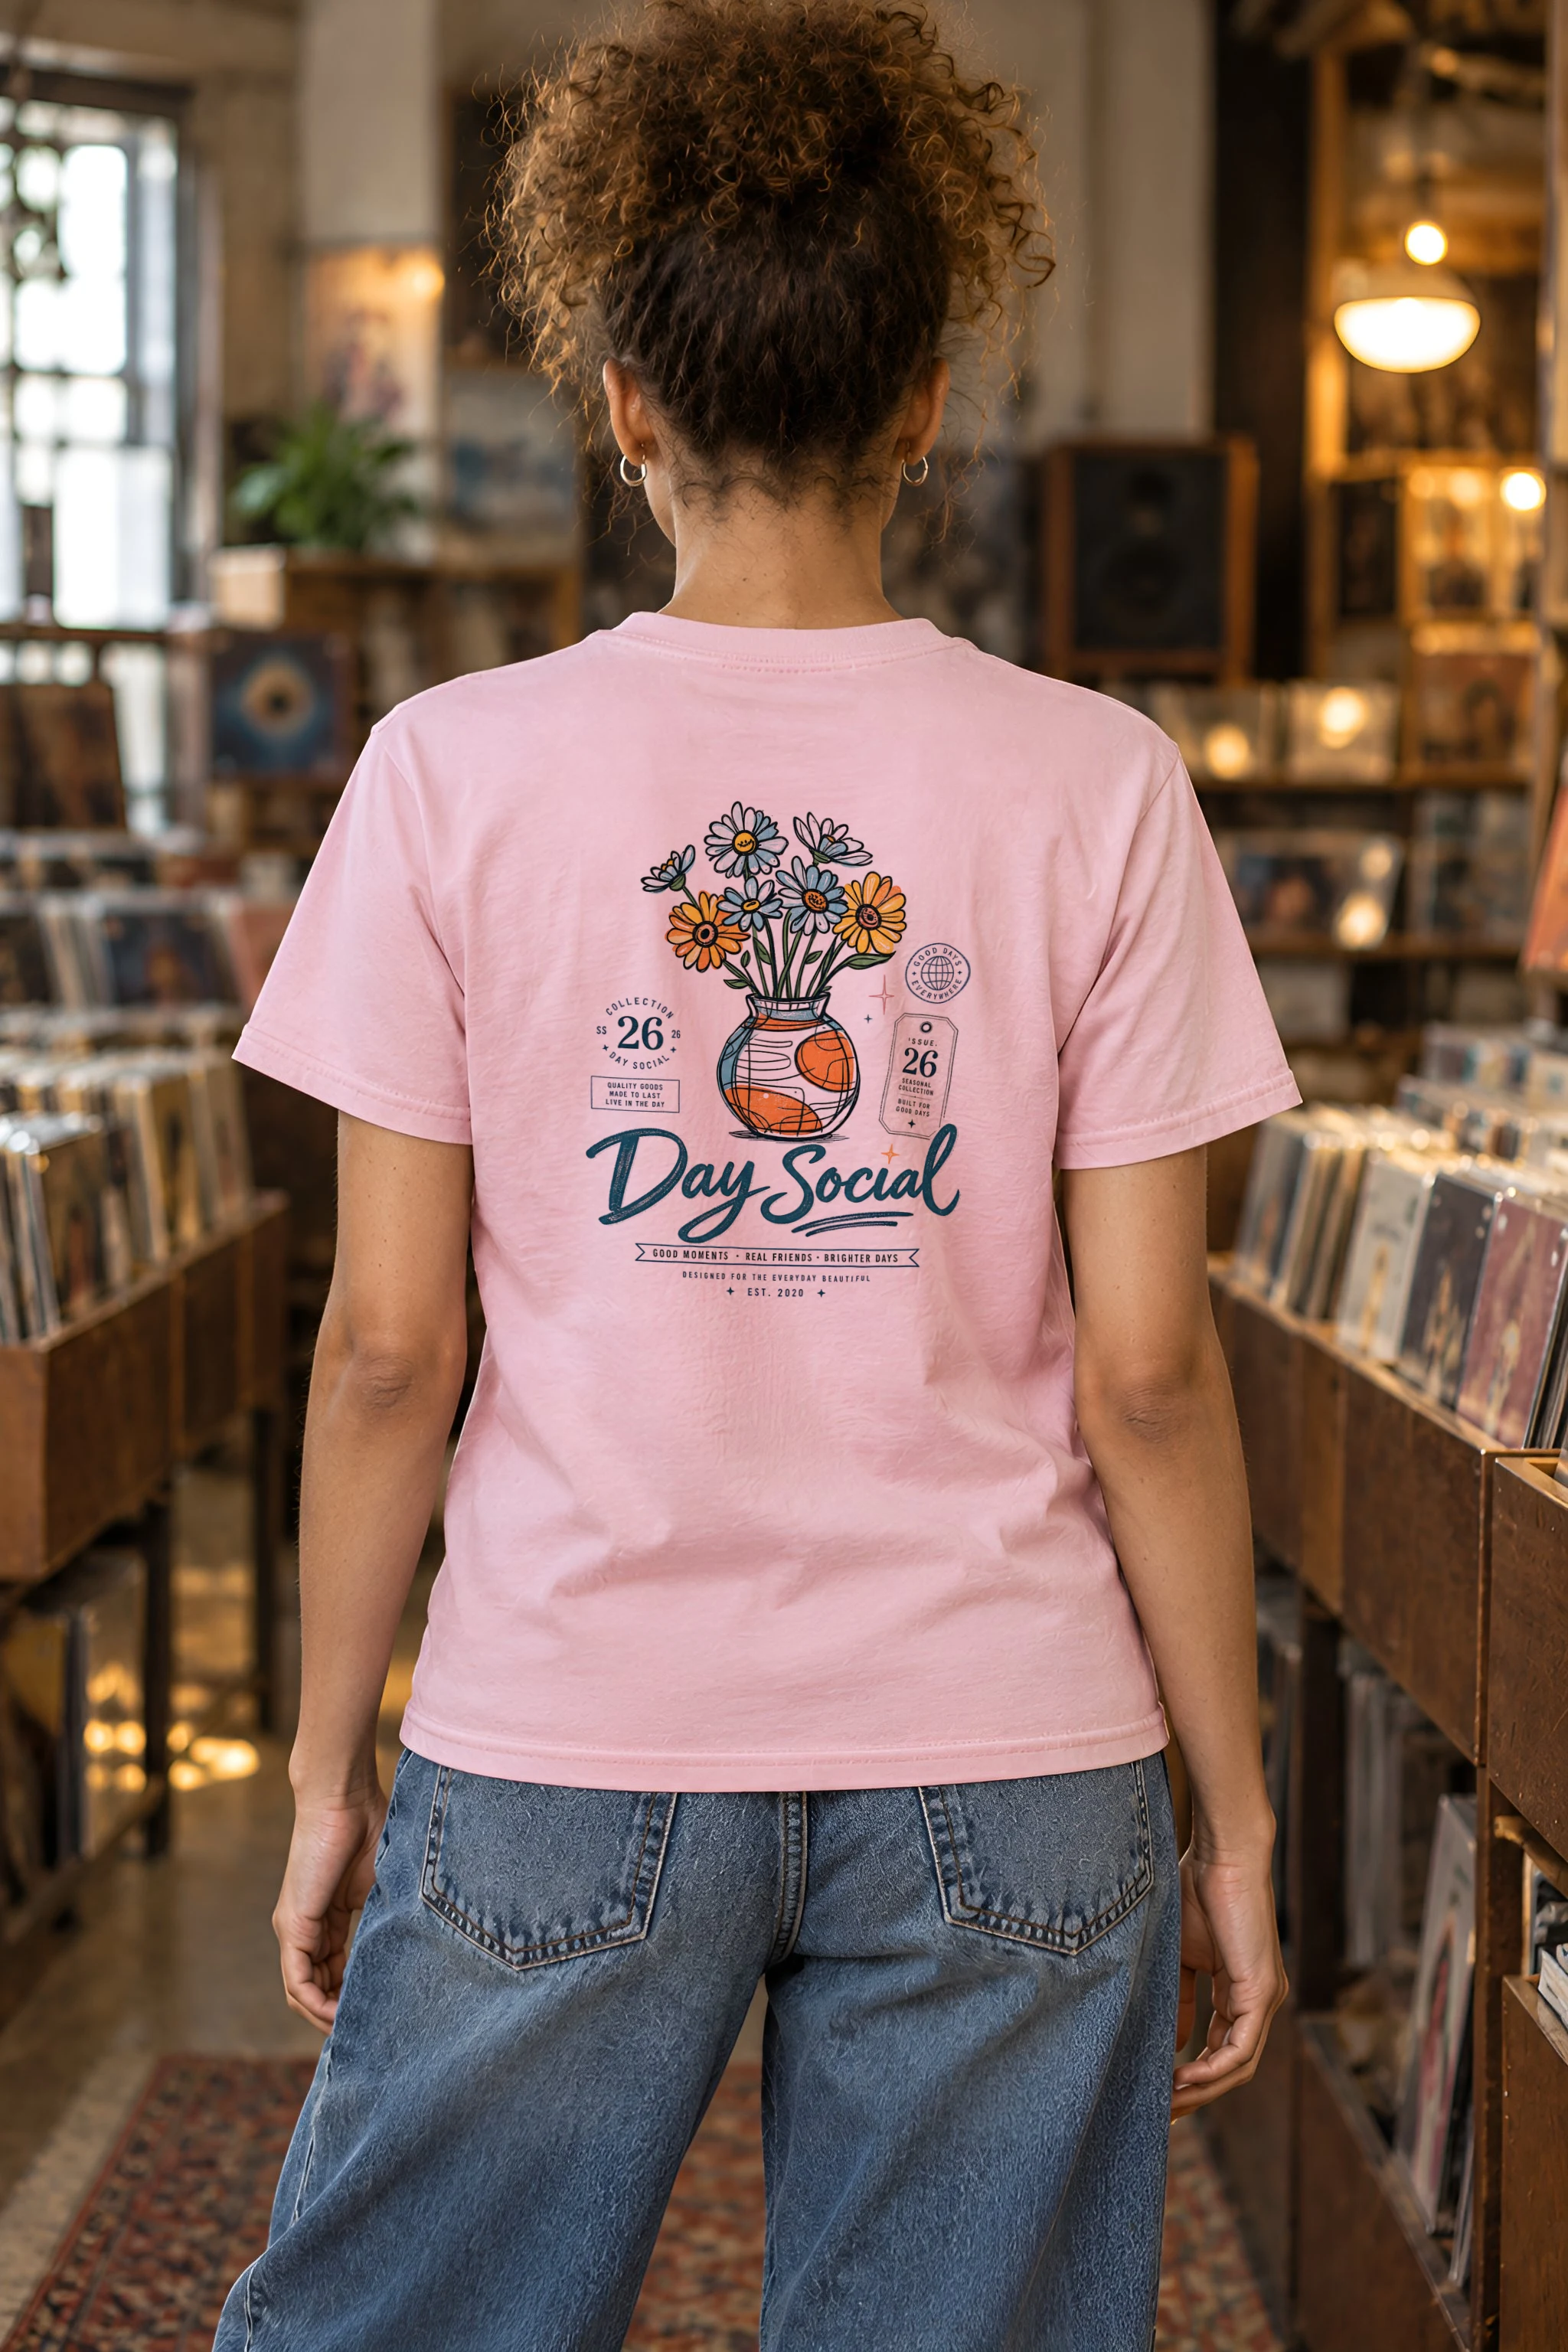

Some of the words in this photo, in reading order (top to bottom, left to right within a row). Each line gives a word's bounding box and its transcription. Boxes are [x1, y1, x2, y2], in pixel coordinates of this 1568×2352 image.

[913, 947, 937, 966] GOOD
[943, 948, 962, 966] DAYS
[912, 978, 962, 1000] EVERYWHERE
[606, 997, 674, 1019] COLLECTION
[596, 1026, 606, 1034] SS
[618, 1016, 664, 1050] 26
[671, 1030, 681, 1039] 26
[609, 1051, 628, 1066] DAY
[632, 1055, 670, 1070] SOCIAL
[902, 1047, 938, 1078] 26
[902, 1078, 931, 1088] SEASONAL
[898, 1085, 934, 1096] COLLECTION
[897, 1098, 916, 1107] BUILT
[586, 1127, 770, 1243] Day
[760, 1123, 960, 1224] Social
[653, 1249, 678, 1258] GOOD
[683, 1250, 729, 1260] MOMENTS
[746, 1253, 767, 1262] REAL
[773, 1253, 812, 1262] FRIENDS
[825, 1254, 871, 1263] BRIGHTER
[876, 1254, 899, 1263] DAYS
[682, 1271, 726, 1280] DESIGNED
[747, 1288, 771, 1297] EST.
[777, 1289, 804, 1297] 2020
